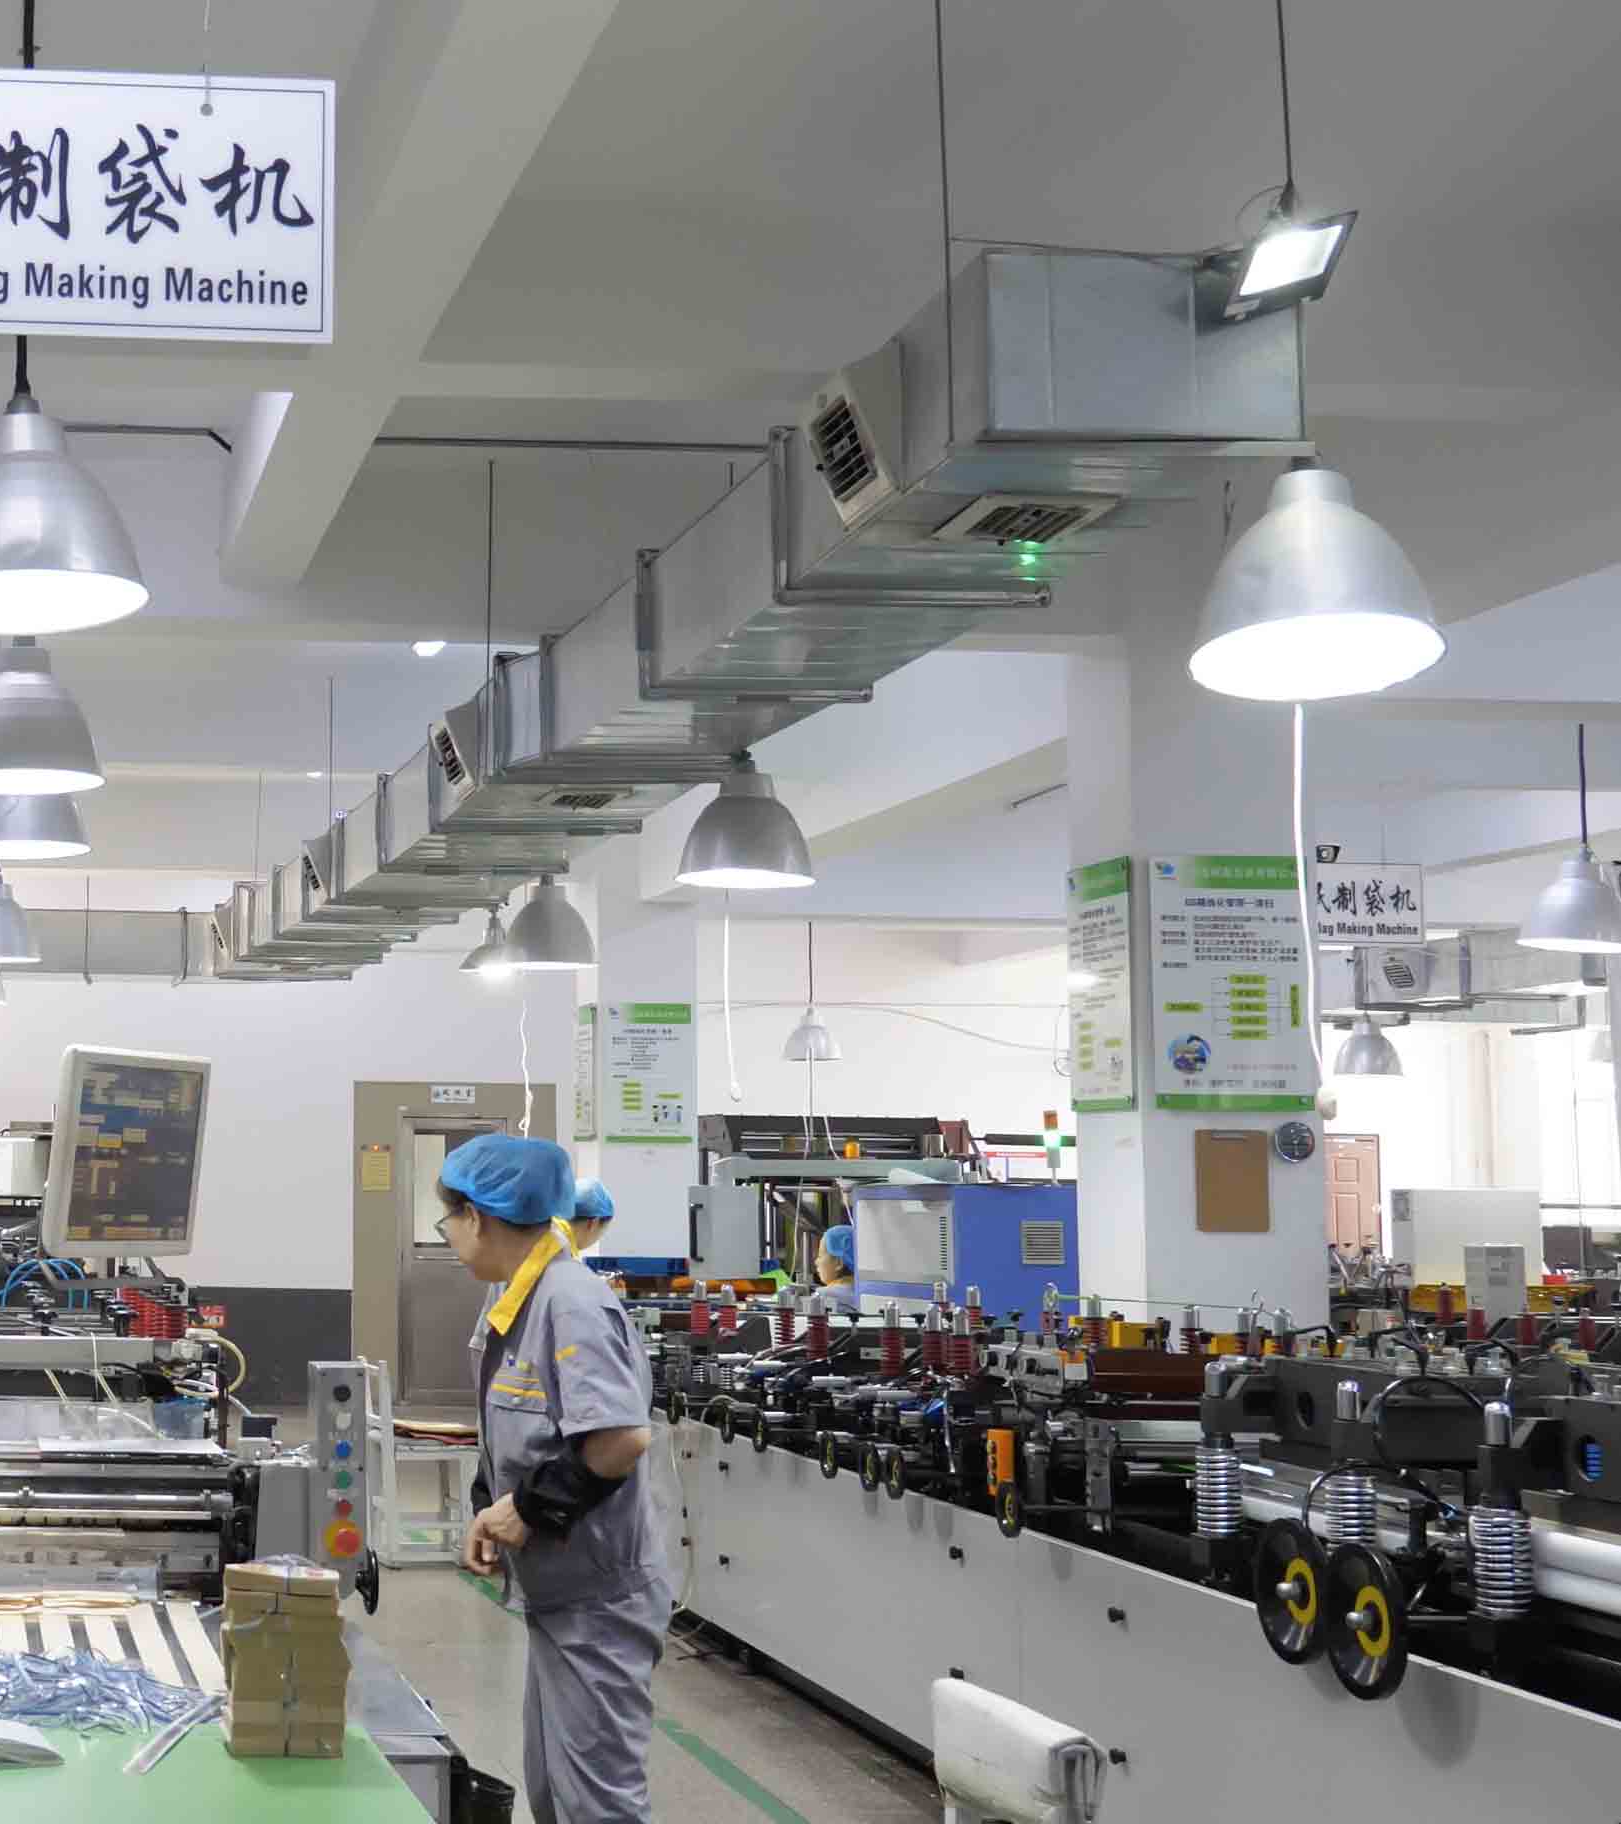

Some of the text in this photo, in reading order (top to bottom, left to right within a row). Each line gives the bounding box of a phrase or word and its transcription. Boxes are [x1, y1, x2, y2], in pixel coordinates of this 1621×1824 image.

[24, 262, 150, 310] Making
[164, 266, 309, 306] Machine
[1336, 921, 1374, 937] Making
[1376, 922, 1419, 936] Machine
